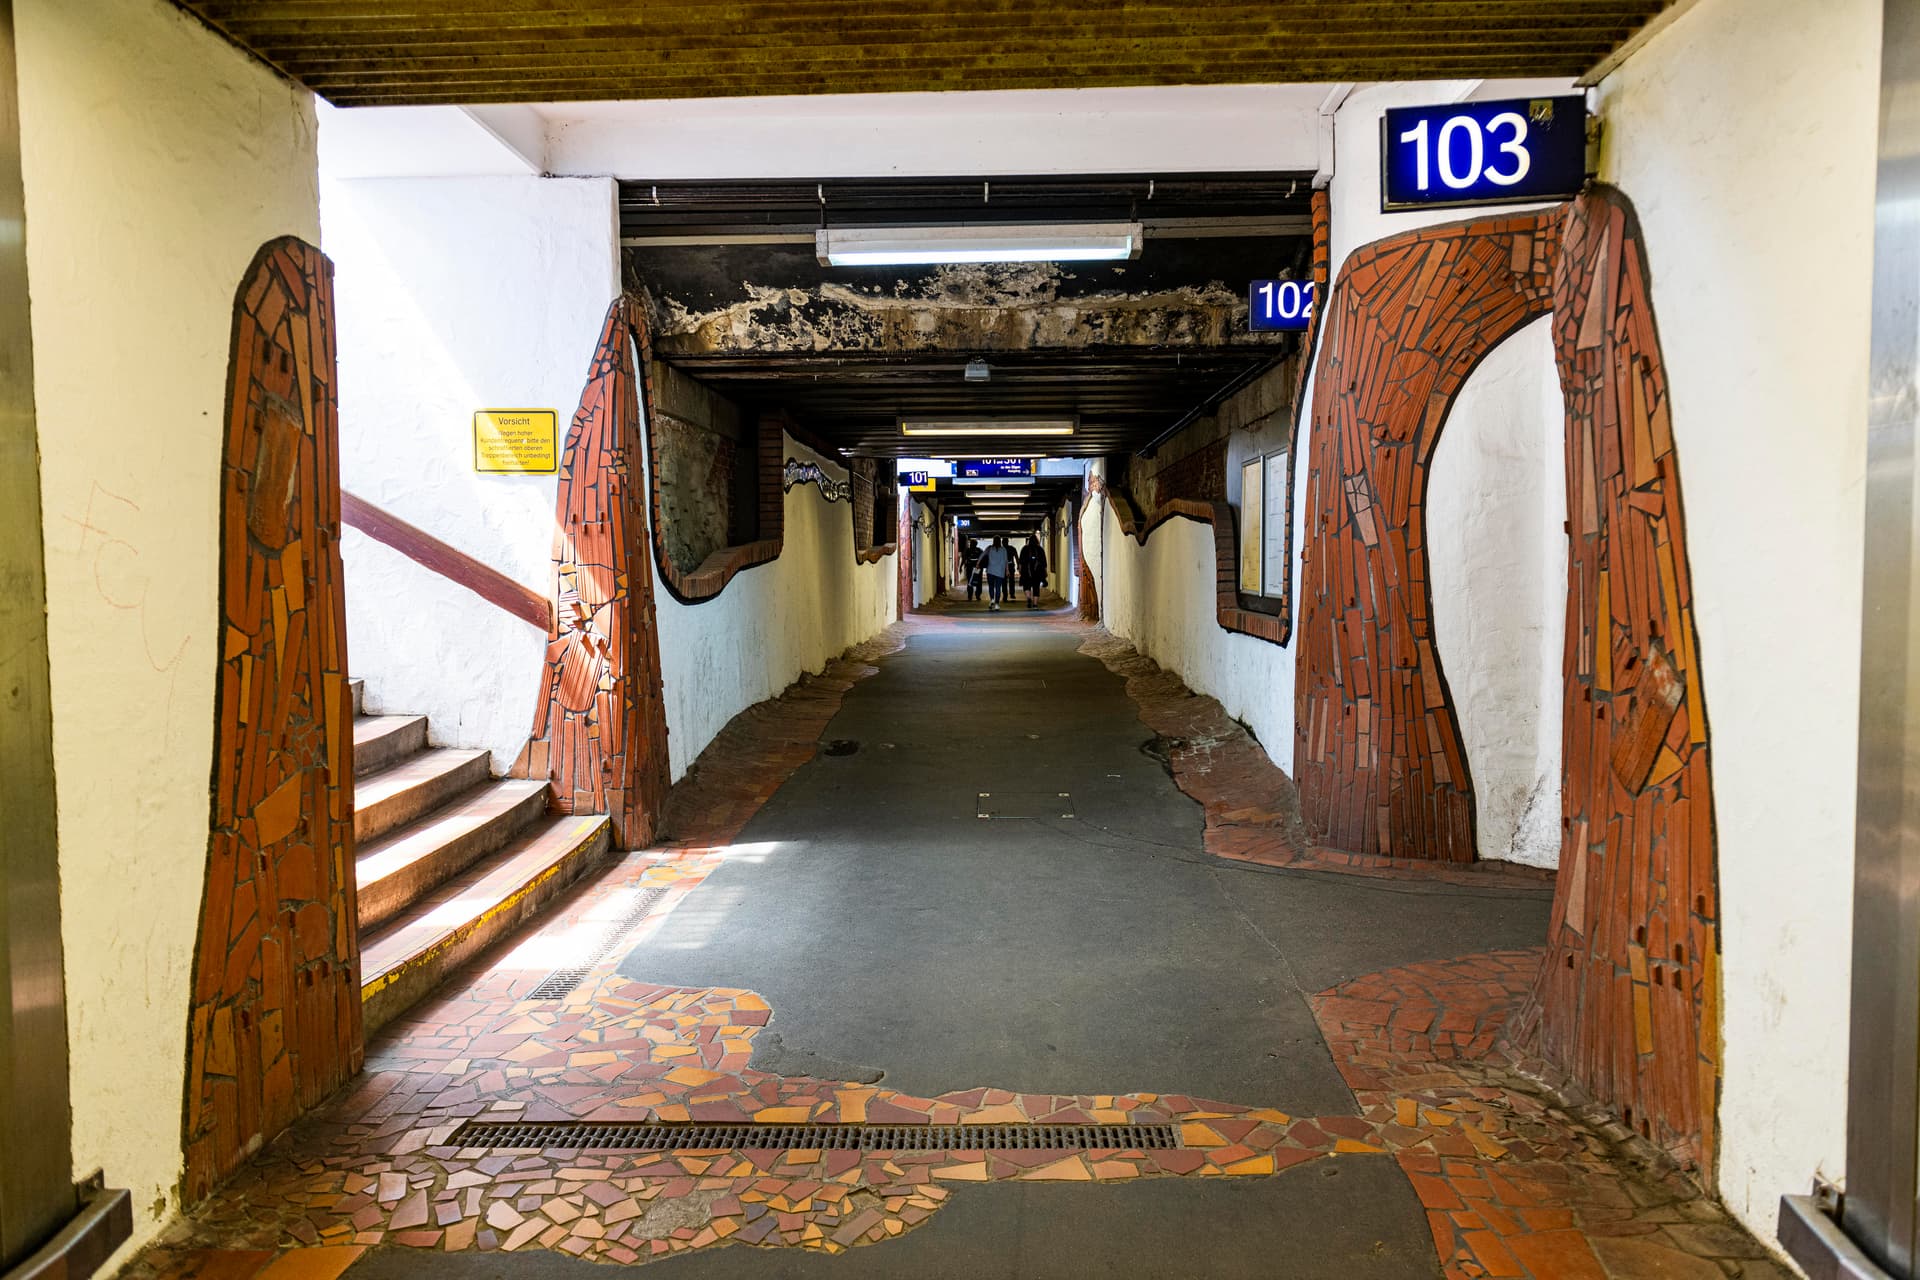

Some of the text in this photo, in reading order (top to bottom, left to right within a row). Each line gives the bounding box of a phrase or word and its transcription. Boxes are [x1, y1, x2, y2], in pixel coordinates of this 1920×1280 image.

[1400, 112, 1531, 190] 103
[1258, 281, 1315, 318] 102
[498, 417, 530, 425] Vorsicht
[909, 471, 928, 483] 101
